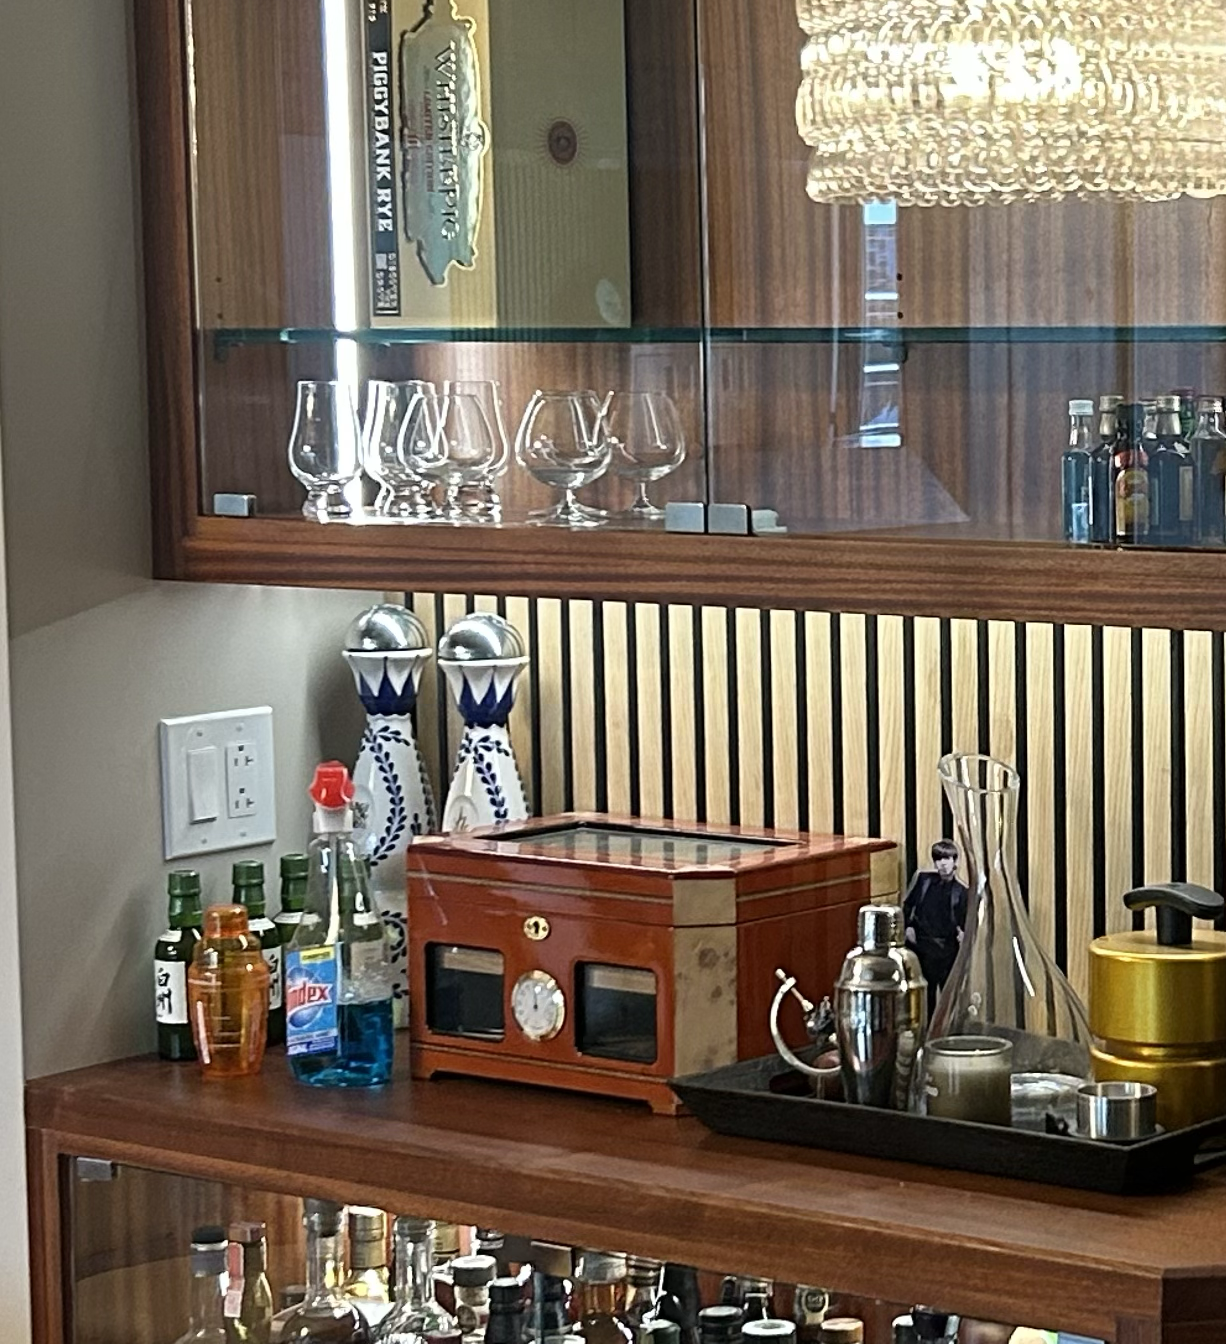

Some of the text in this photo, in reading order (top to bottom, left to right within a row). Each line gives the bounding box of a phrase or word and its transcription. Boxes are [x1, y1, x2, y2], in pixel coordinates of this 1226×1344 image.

[371, 51, 394, 232] PIGGYBANK RYE
[156, 967, 173, 1015] 白州
